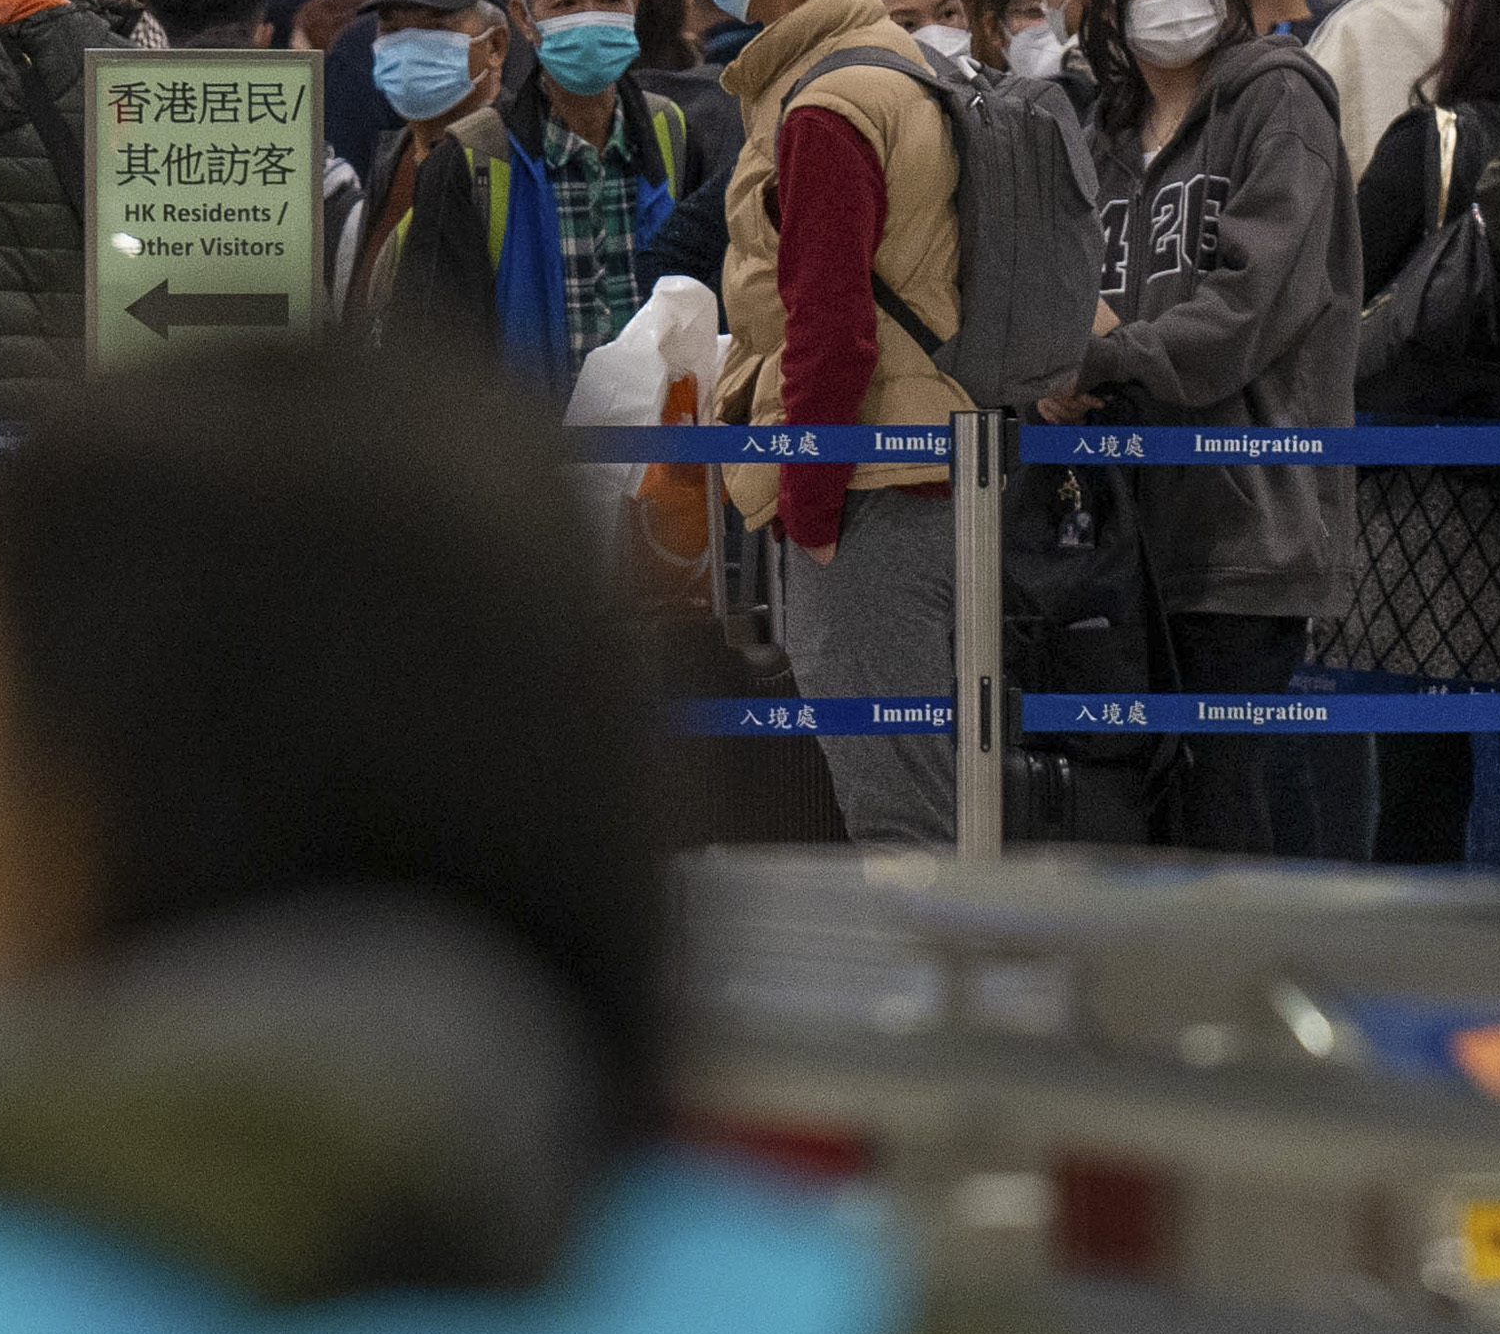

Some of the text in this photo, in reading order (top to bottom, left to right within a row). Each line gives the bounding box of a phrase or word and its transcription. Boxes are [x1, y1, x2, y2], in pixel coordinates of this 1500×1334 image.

[107, 79, 306, 125] 香港居民/
[115, 142, 297, 188] 其他訪客
[124, 201, 289, 226] HK Residents /
[201, 236, 285, 257] Visitors
[741, 432, 952, 458] 入境處 Immig
[1072, 432, 1324, 458] 入境處 Immigration
[739, 703, 819, 730] 入境處
[1075, 700, 1328, 726] 入境處 Immigration
